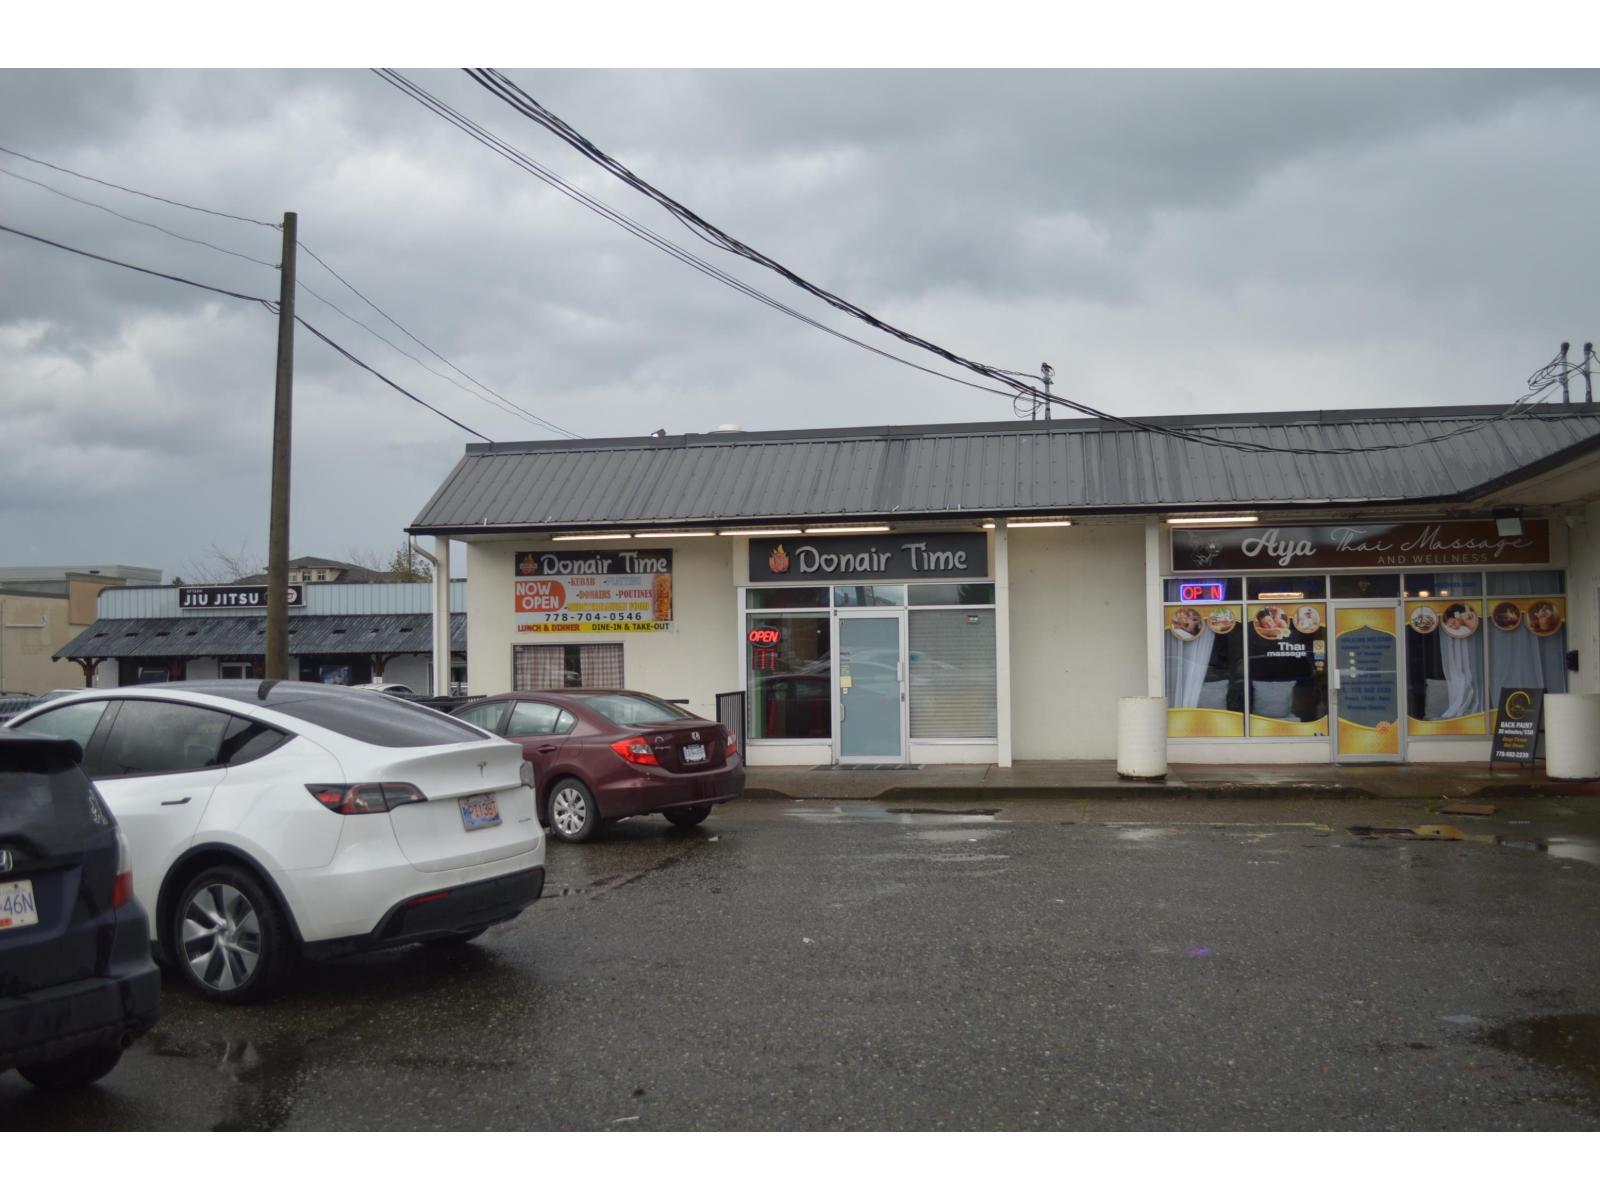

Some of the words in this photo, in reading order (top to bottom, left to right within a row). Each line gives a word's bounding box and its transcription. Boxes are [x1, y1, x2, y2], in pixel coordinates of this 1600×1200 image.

[1241, 528, 1316, 566] Aya
[1331, 527, 1393, 552] Thai
[1400, 525, 1534, 557] Massage
[540, 554, 612, 575] Donair
[618, 551, 667, 573] Time
[796, 546, 891, 572] Donair
[902, 542, 967, 571] Time
[1377, 555, 1406, 564] AND
[1413, 553, 1489, 564] WELLNESS
[516, 582, 551, 596] NOW
[1183, 587, 1221, 600] OPN
[184, 594, 208, 606] JIU
[214, 593, 259, 605] JITSU
[522, 596, 560, 609] OPEN
[544, 612, 642, 622] 778-704-0546
[517, 624, 541, 632] LUNCH
[551, 623, 580, 631] DINNER
[592, 623, 622, 631] DINE-IN
[632, 622, 669, 631] TAKE-OUT
[749, 630, 779, 643] OPEN
[1277, 642, 1305, 651] Thai
